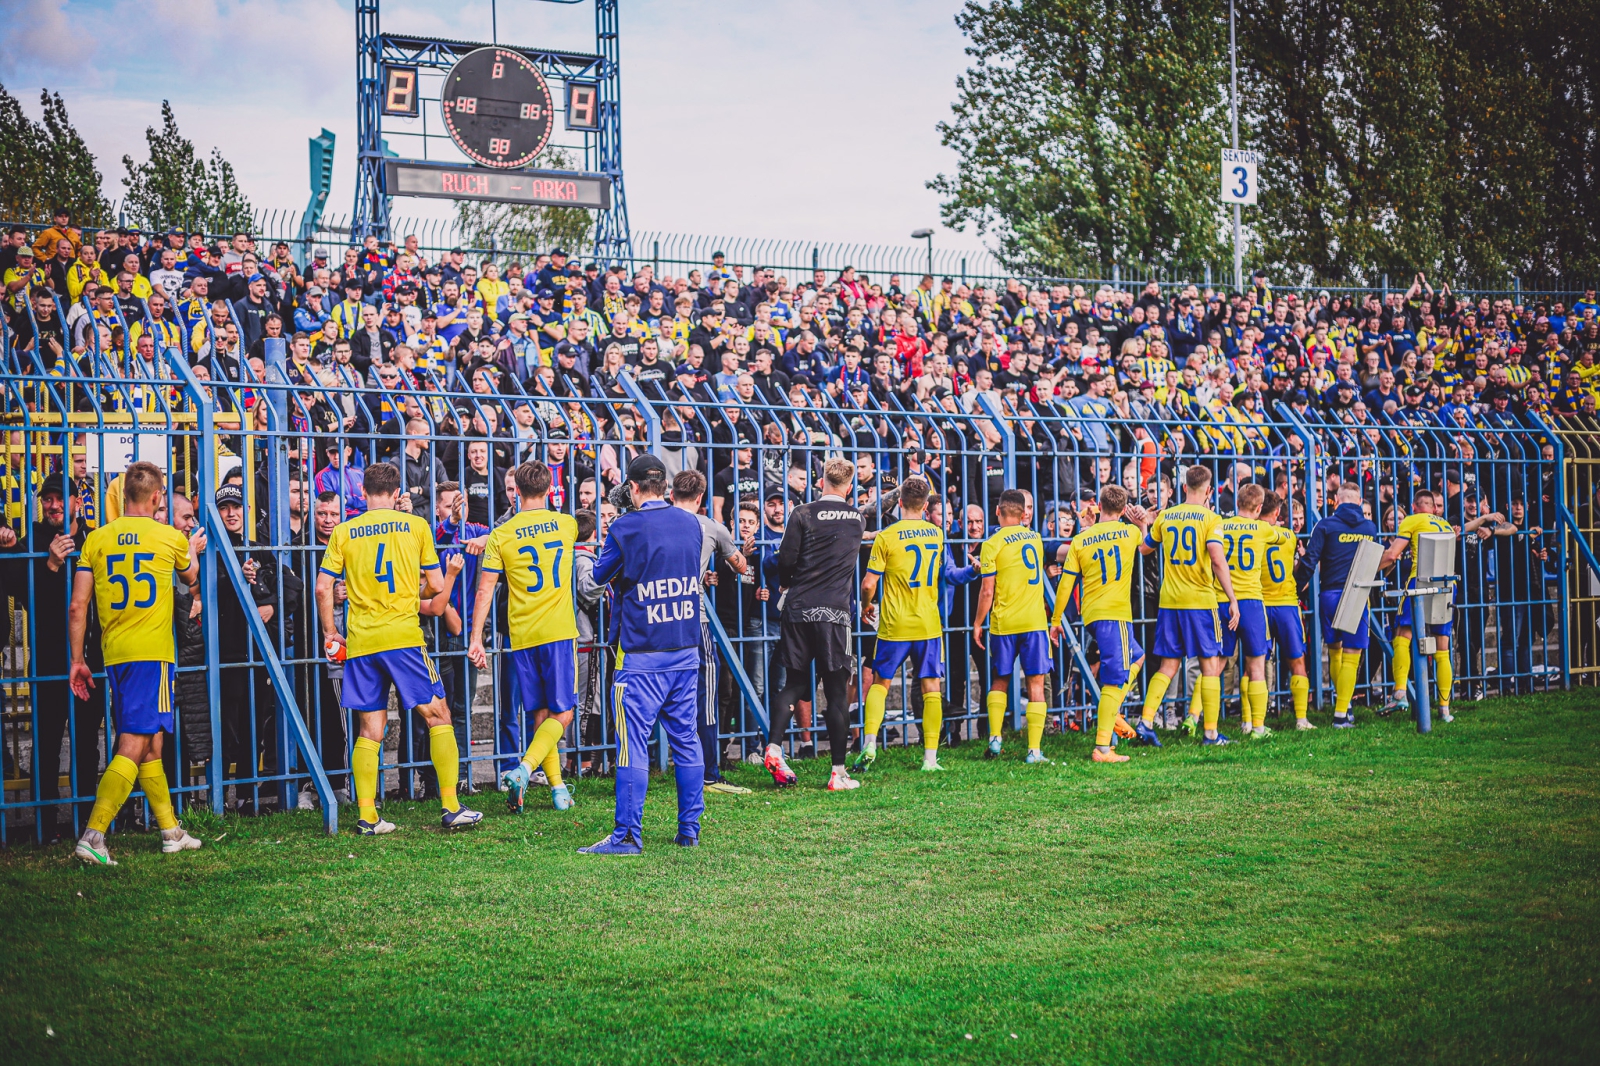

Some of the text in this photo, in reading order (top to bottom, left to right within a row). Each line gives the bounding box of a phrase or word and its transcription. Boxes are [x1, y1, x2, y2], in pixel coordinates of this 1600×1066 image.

[386, 71, 415, 111] 2
[571, 88, 596, 125] 4
[1223, 149, 1256, 164] SEKTOR
[441, 172, 489, 195] RUCH
[532, 179, 578, 201] ARKA
[1232, 166, 1248, 198] 3
[120, 435, 140, 444] DÓ
[349, 520, 411, 540] DOBROTKA
[515, 519, 559, 540] STĘPIEŃ
[816, 510, 862, 523] GDYNIA
[1164, 512, 1205, 522] MARCJANIK
[1222, 523, 1258, 531] URZYCKI
[117, 532, 141, 546] GOL
[897, 528, 939, 540] ZIEMANN
[1082, 529, 1130, 547] ADAMCZYK
[1166, 525, 1197, 566] 29
[518, 540, 564, 593] 37
[905, 543, 939, 588] 27
[1021, 543, 1040, 585] 9
[1091, 544, 1122, 585] 11
[1223, 533, 1255, 571] 26
[1266, 545, 1286, 583] 6
[106, 552, 157, 610] 55
[374, 542, 396, 594] 4
[636, 576, 700, 602] MEDIA
[646, 600, 695, 624] KLUB
